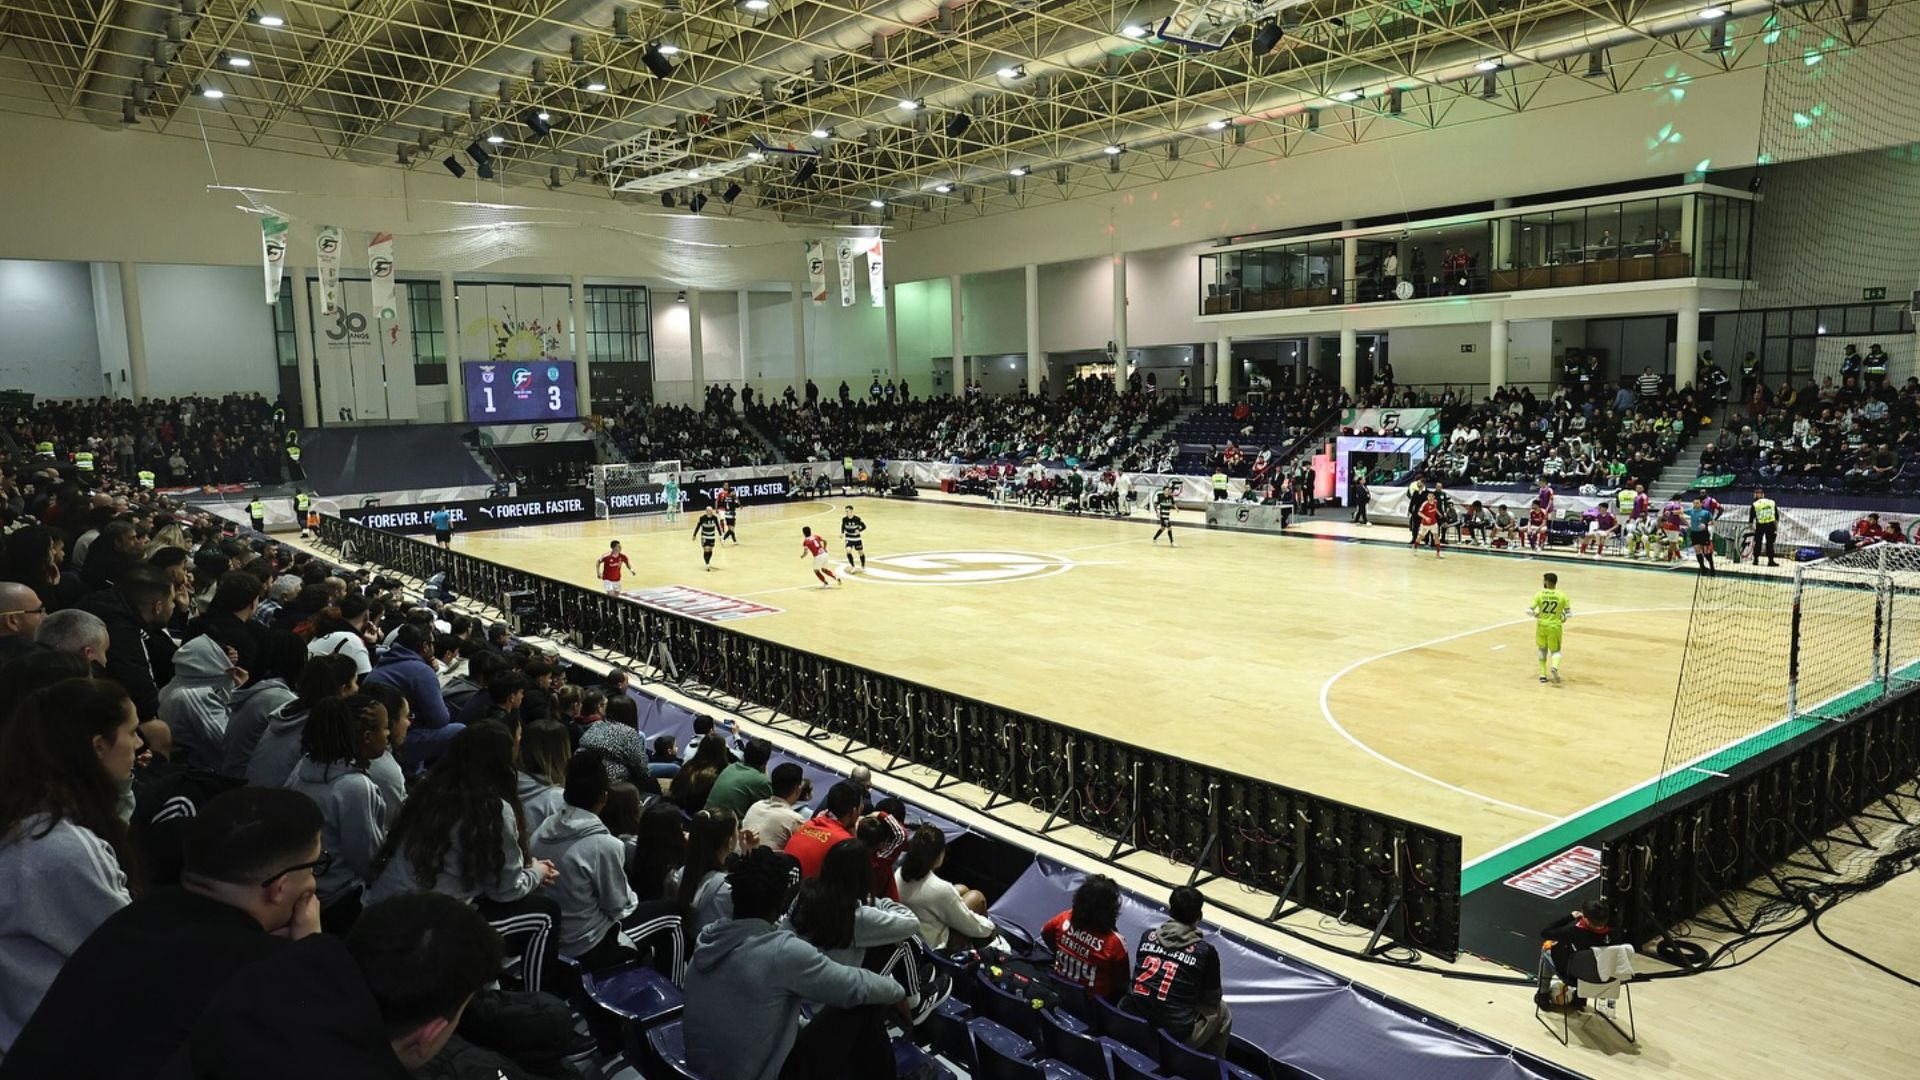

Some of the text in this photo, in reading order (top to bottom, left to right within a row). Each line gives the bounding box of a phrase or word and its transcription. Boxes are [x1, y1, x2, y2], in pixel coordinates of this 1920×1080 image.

[483, 386, 561, 413] 1 3
[753, 483, 785, 496] FASTER.
[497, 499, 585, 518] FOREVER. FASTER.
[611, 493, 654, 508] FOREVER.
[368, 510, 422, 528] FOREVER.
[1542, 600, 1558, 614] 22
[1067, 926, 1104, 951] SAGRES
[1132, 955, 1179, 1001] 21
